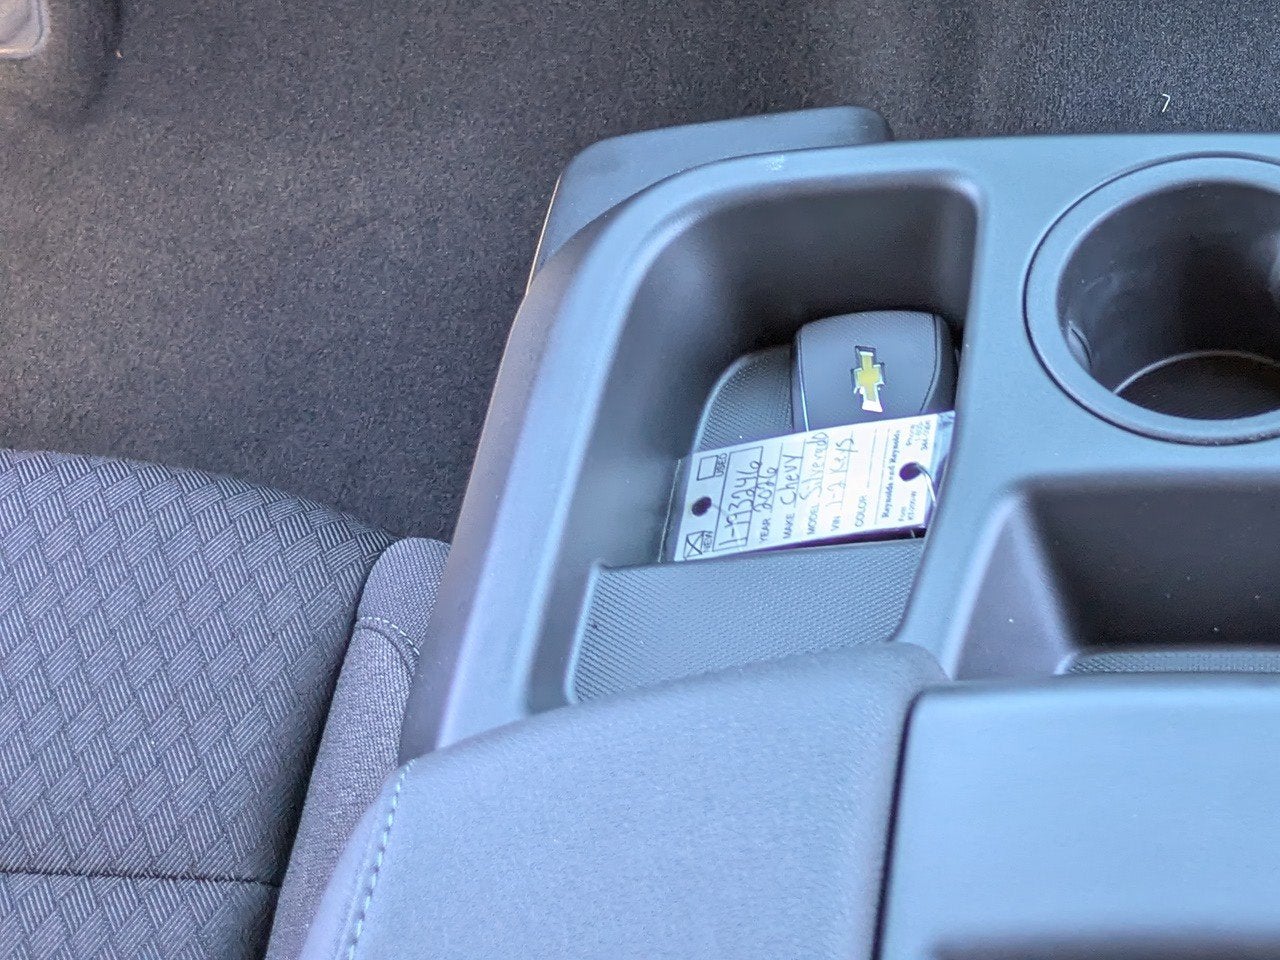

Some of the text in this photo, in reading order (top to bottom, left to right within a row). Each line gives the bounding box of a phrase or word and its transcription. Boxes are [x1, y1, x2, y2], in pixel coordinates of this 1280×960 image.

[715, 453, 728, 477] USED
[776, 454, 803, 505] Chevy
[798, 432, 829, 500] Silverado
[753, 467, 777, 512] 2026
[882, 482, 894, 518] Reynolds
[782, 513, 794, 538] MAKE
[807, 504, 819, 535] MODEL
[830, 516, 841, 531] VIN
[854, 495, 867, 527] COLOR
[759, 518, 770, 543] YEAR
